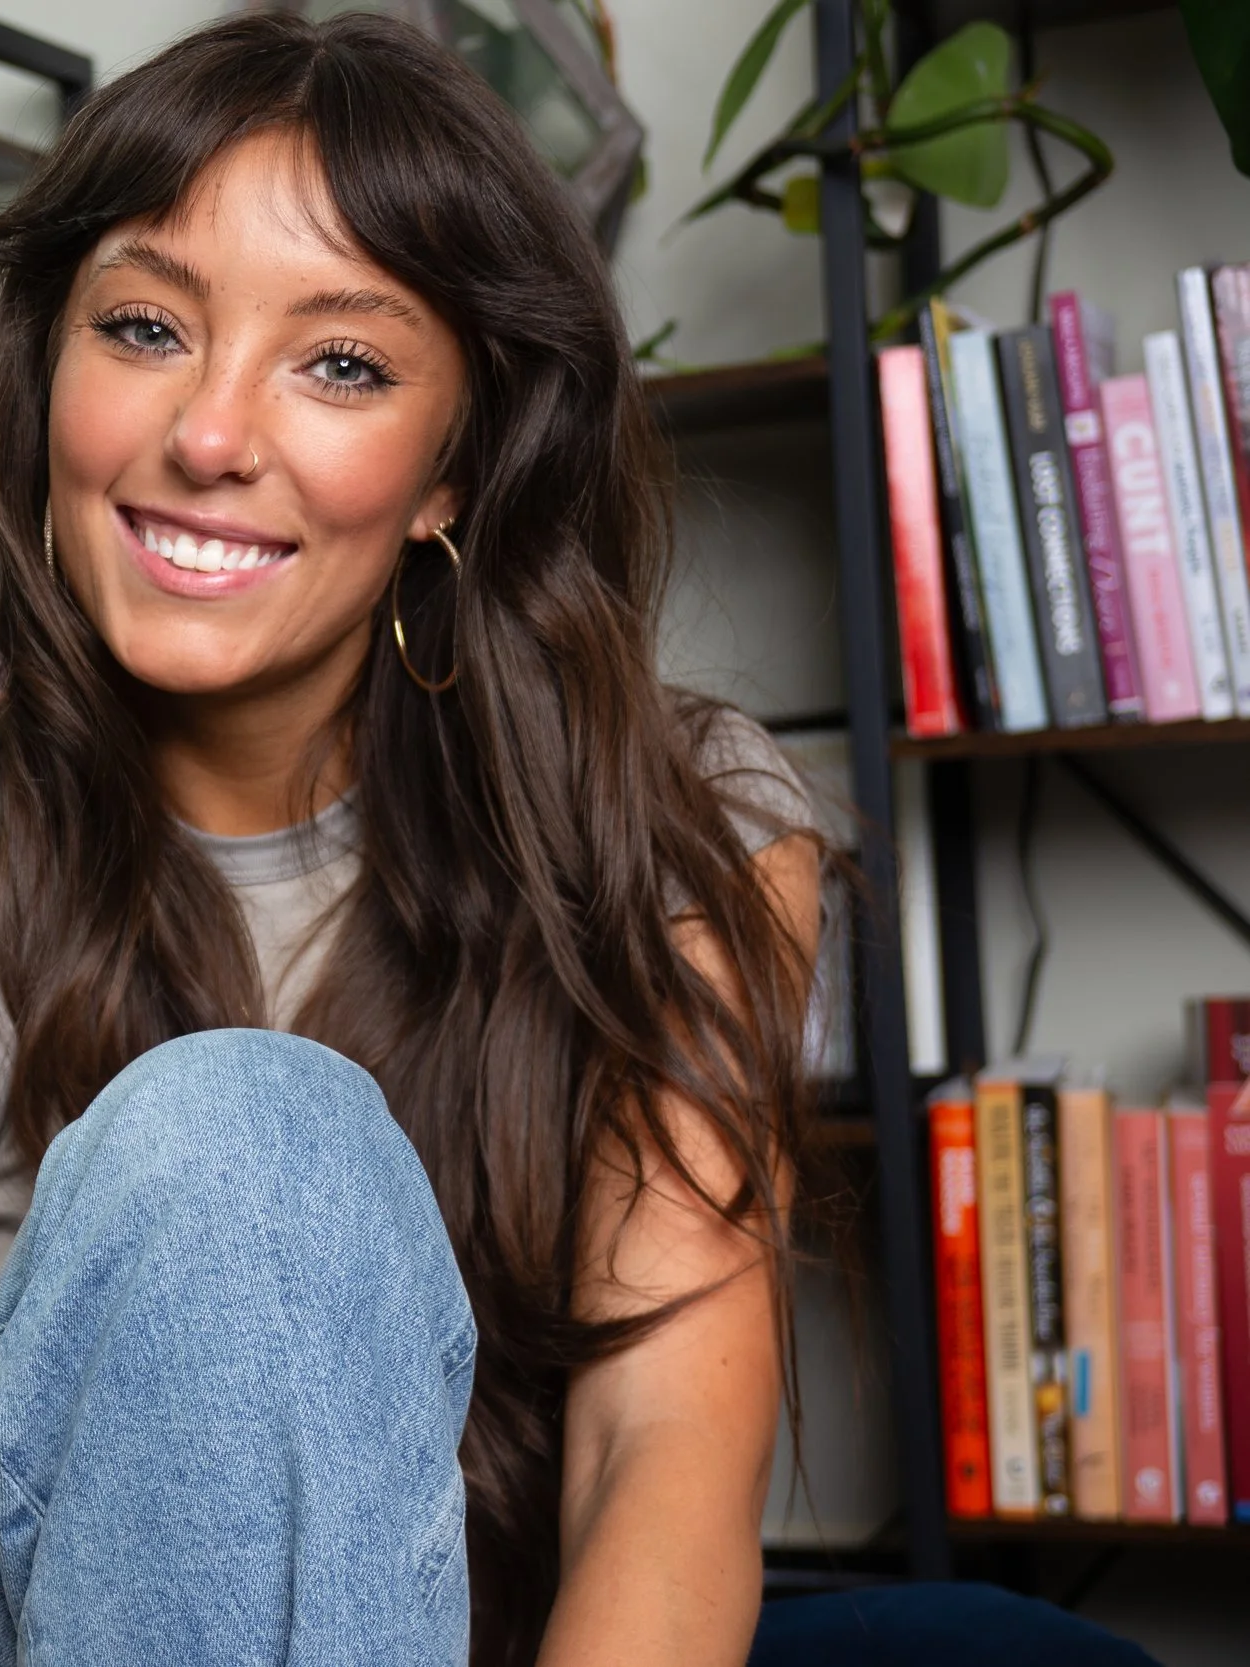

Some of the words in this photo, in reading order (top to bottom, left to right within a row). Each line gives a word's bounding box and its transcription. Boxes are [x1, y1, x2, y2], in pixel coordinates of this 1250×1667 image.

[1029, 451, 1061, 505] LOST
[1113, 421, 1171, 555] CUNT
[1037, 506, 1083, 656] CONNECTIONS
